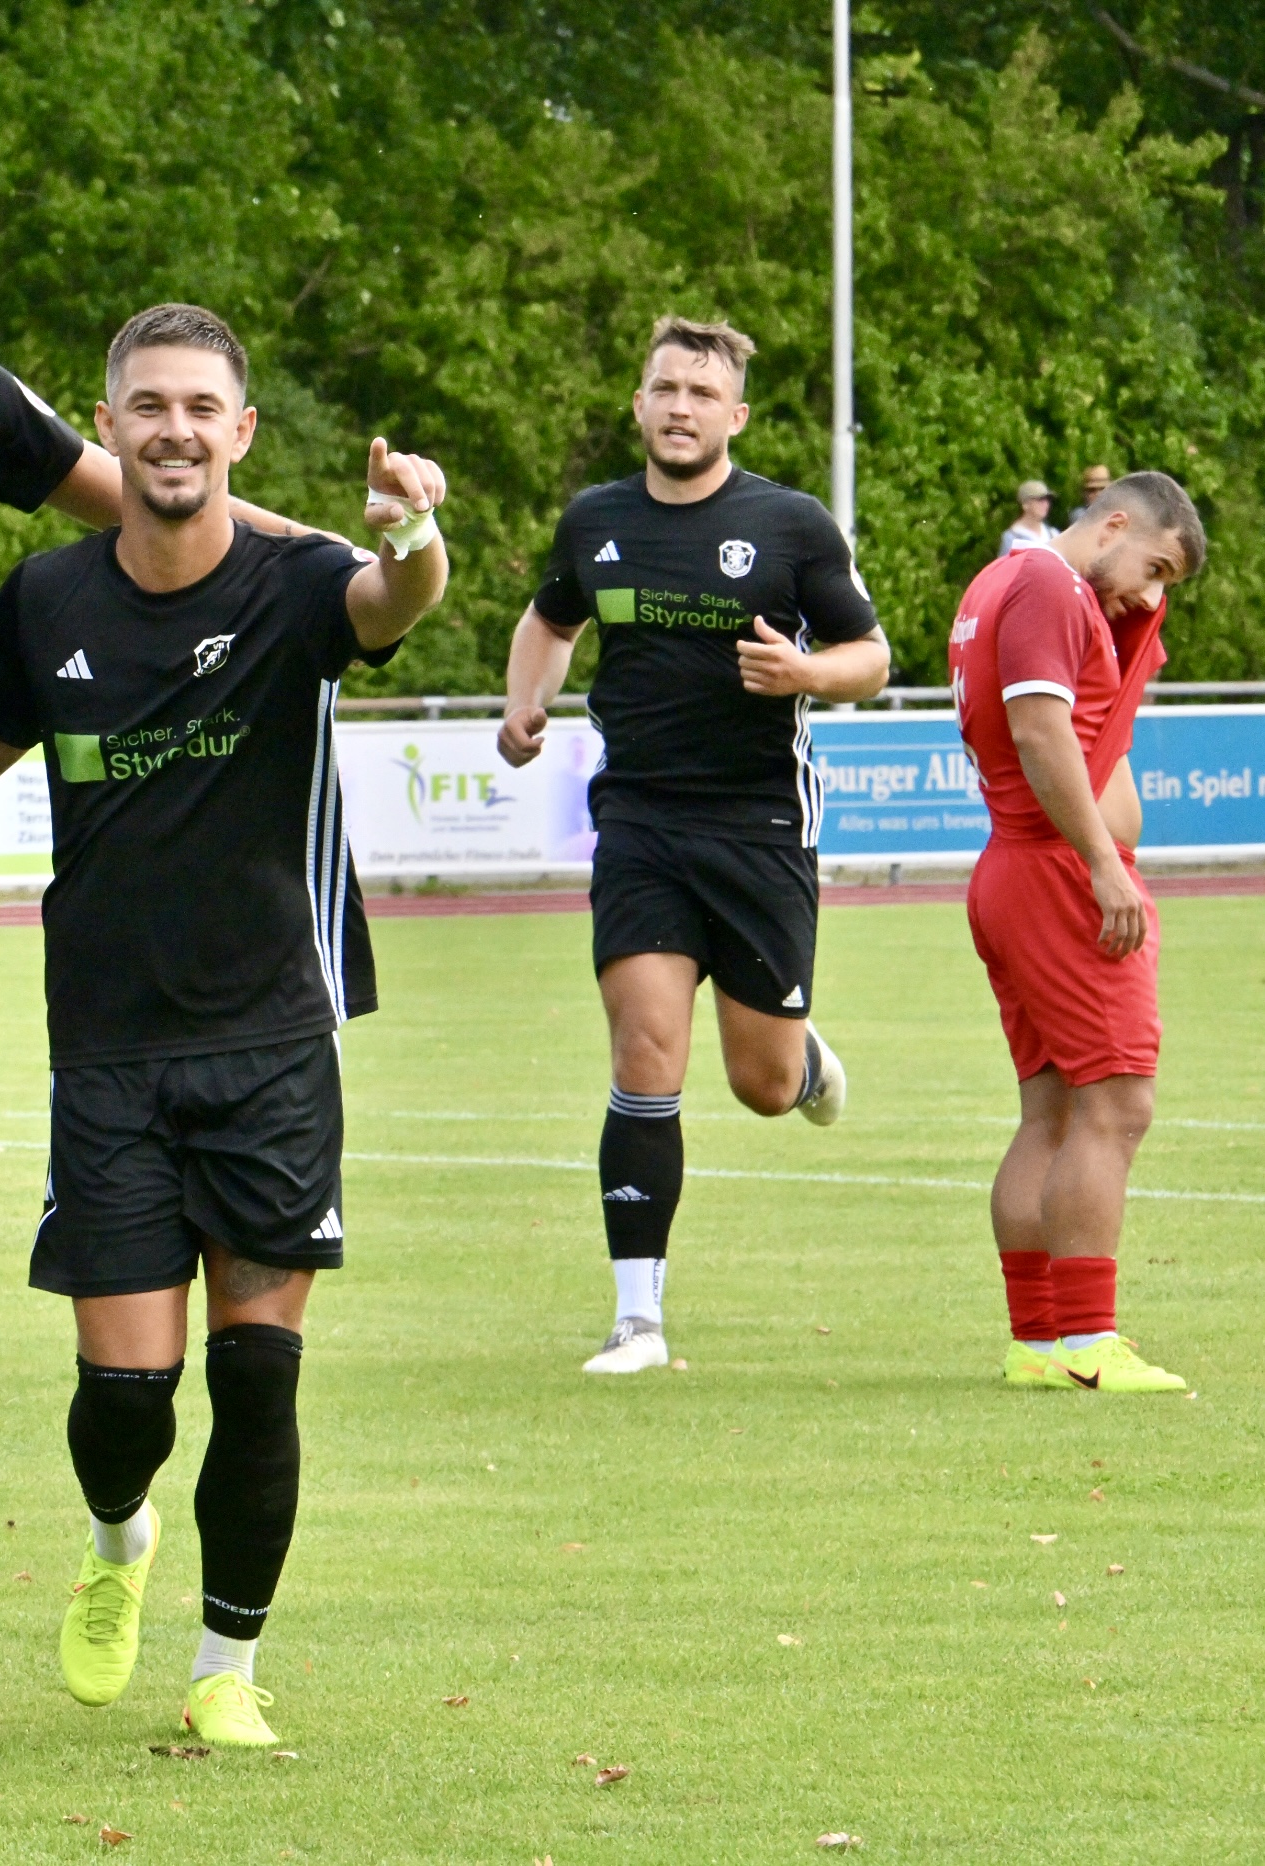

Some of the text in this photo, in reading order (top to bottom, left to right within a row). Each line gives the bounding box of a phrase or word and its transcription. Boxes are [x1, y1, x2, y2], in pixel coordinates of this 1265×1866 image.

[640, 588, 745, 610] Sicher. Stark.
[106, 726, 178, 750] Sicher.
[1141, 769, 1182, 800] Ein
[1188, 767, 1252, 807] Spiel
